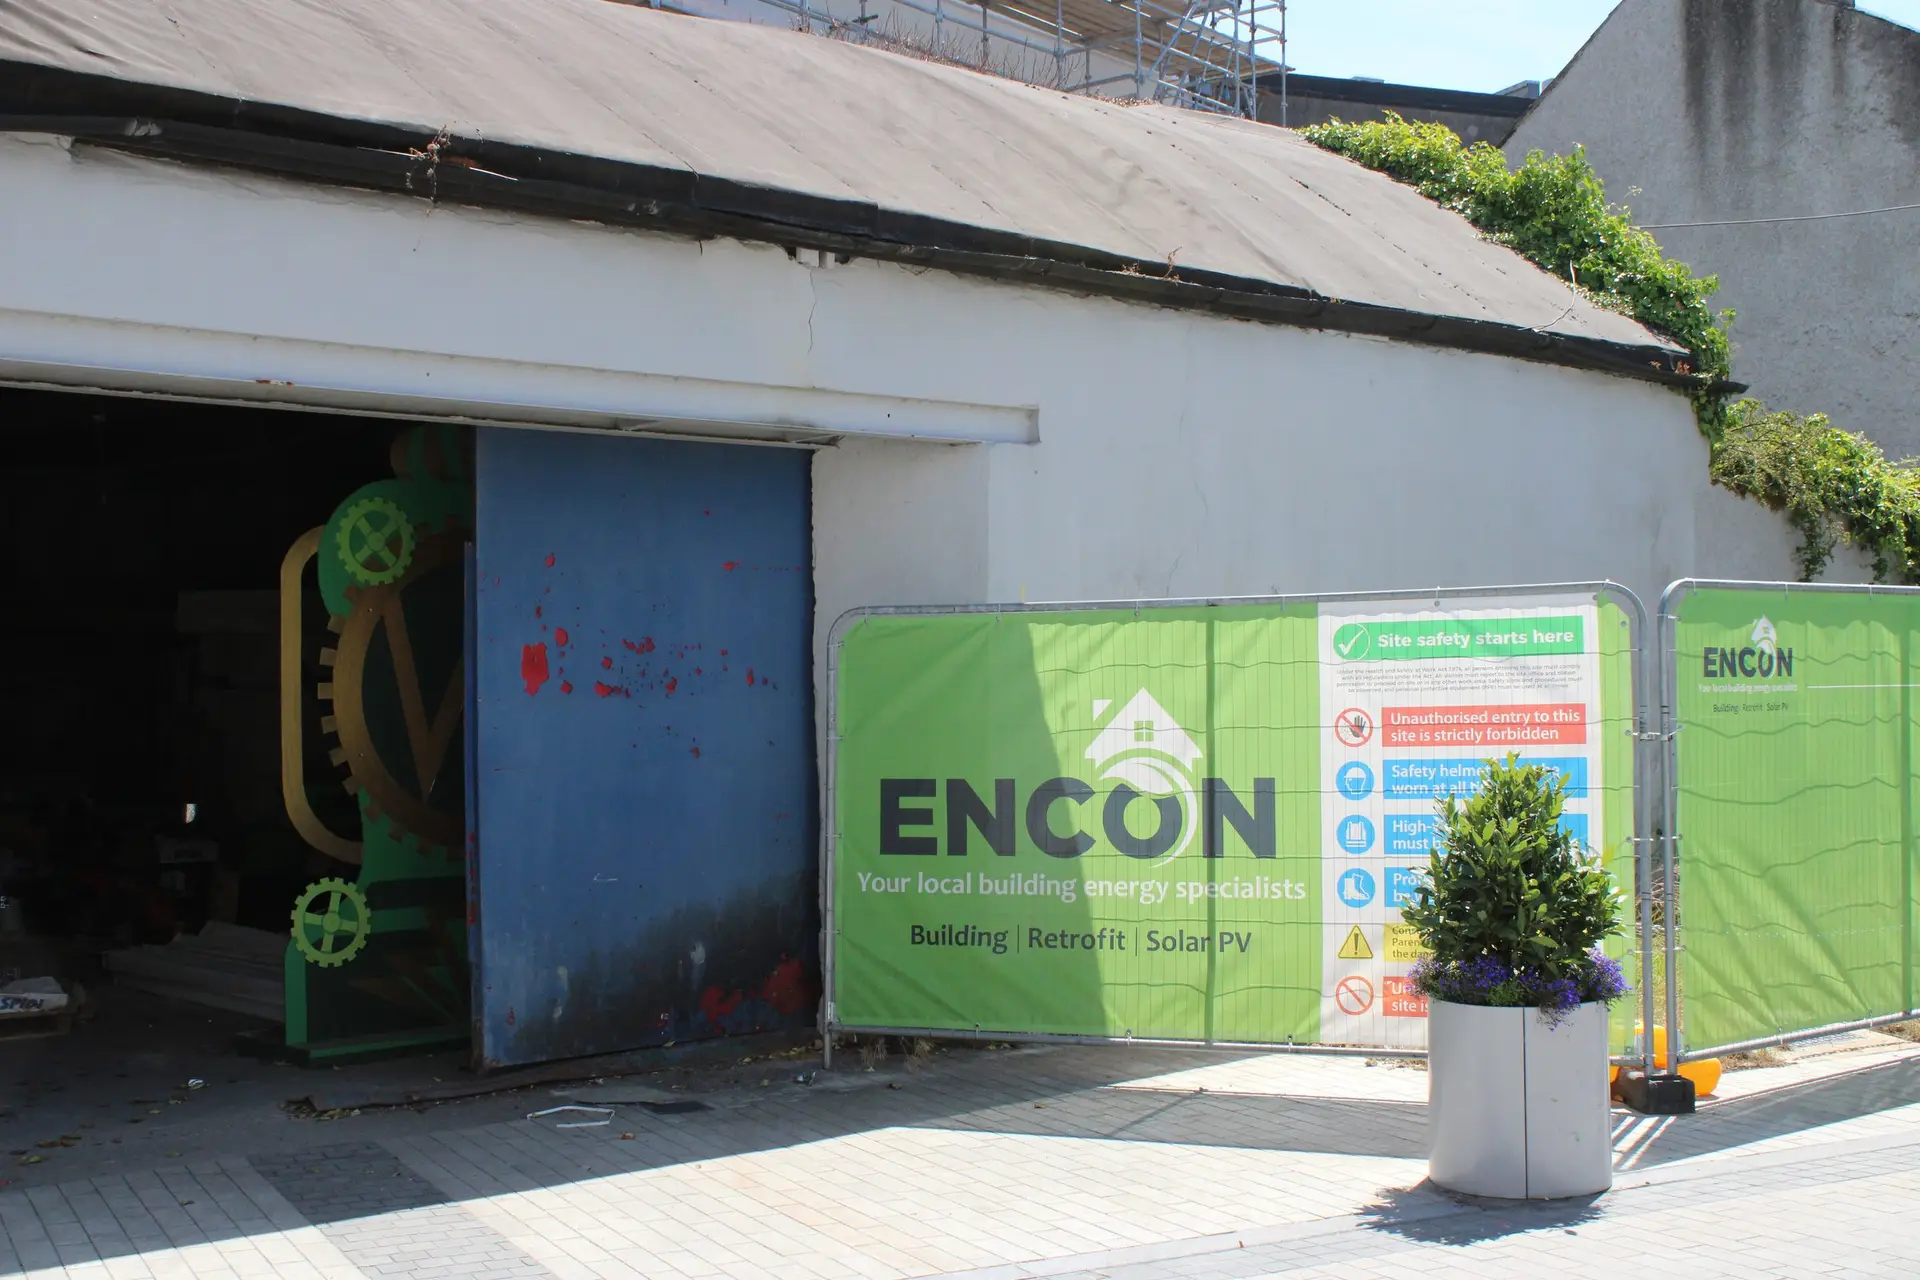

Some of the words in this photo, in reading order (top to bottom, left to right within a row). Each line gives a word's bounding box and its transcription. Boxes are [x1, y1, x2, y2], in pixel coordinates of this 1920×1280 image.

[1378, 633, 1412, 648] Site
[1416, 632, 1470, 649] safety
[1475, 631, 1528, 645] starts
[1532, 629, 1575, 643] here
[1703, 647, 1793, 678] ENCON
[1390, 711, 1489, 725] Unauthorised
[1492, 711, 1531, 727] entry
[1534, 710, 1550, 722] to
[1553, 709, 1580, 722] this
[1391, 729, 1416, 742] site
[1419, 729, 1431, 741] is
[1434, 727, 1483, 744] strictly
[1487, 727, 1559, 741] forbidden
[1392, 764, 1437, 780] Safety
[1392, 784, 1429, 794] worn
[1432, 782, 1447, 794] at
[1450, 781, 1466, 794] all
[879, 777, 1276, 860] ENCON
[1393, 838, 1429, 850] must
[857, 872, 912, 893] Your
[917, 871, 972, 894] local
[979, 872, 1077, 903] building
[1084, 878, 1169, 905] energy
[1175, 876, 1306, 905] specialists
[910, 924, 1009, 954] Building
[1028, 926, 1126, 950] Retrofit
[1146, 929, 1211, 952] Solar
[1219, 931, 1252, 953] PV
[1392, 949, 1409, 958] the
[1391, 999, 1417, 1012] site
